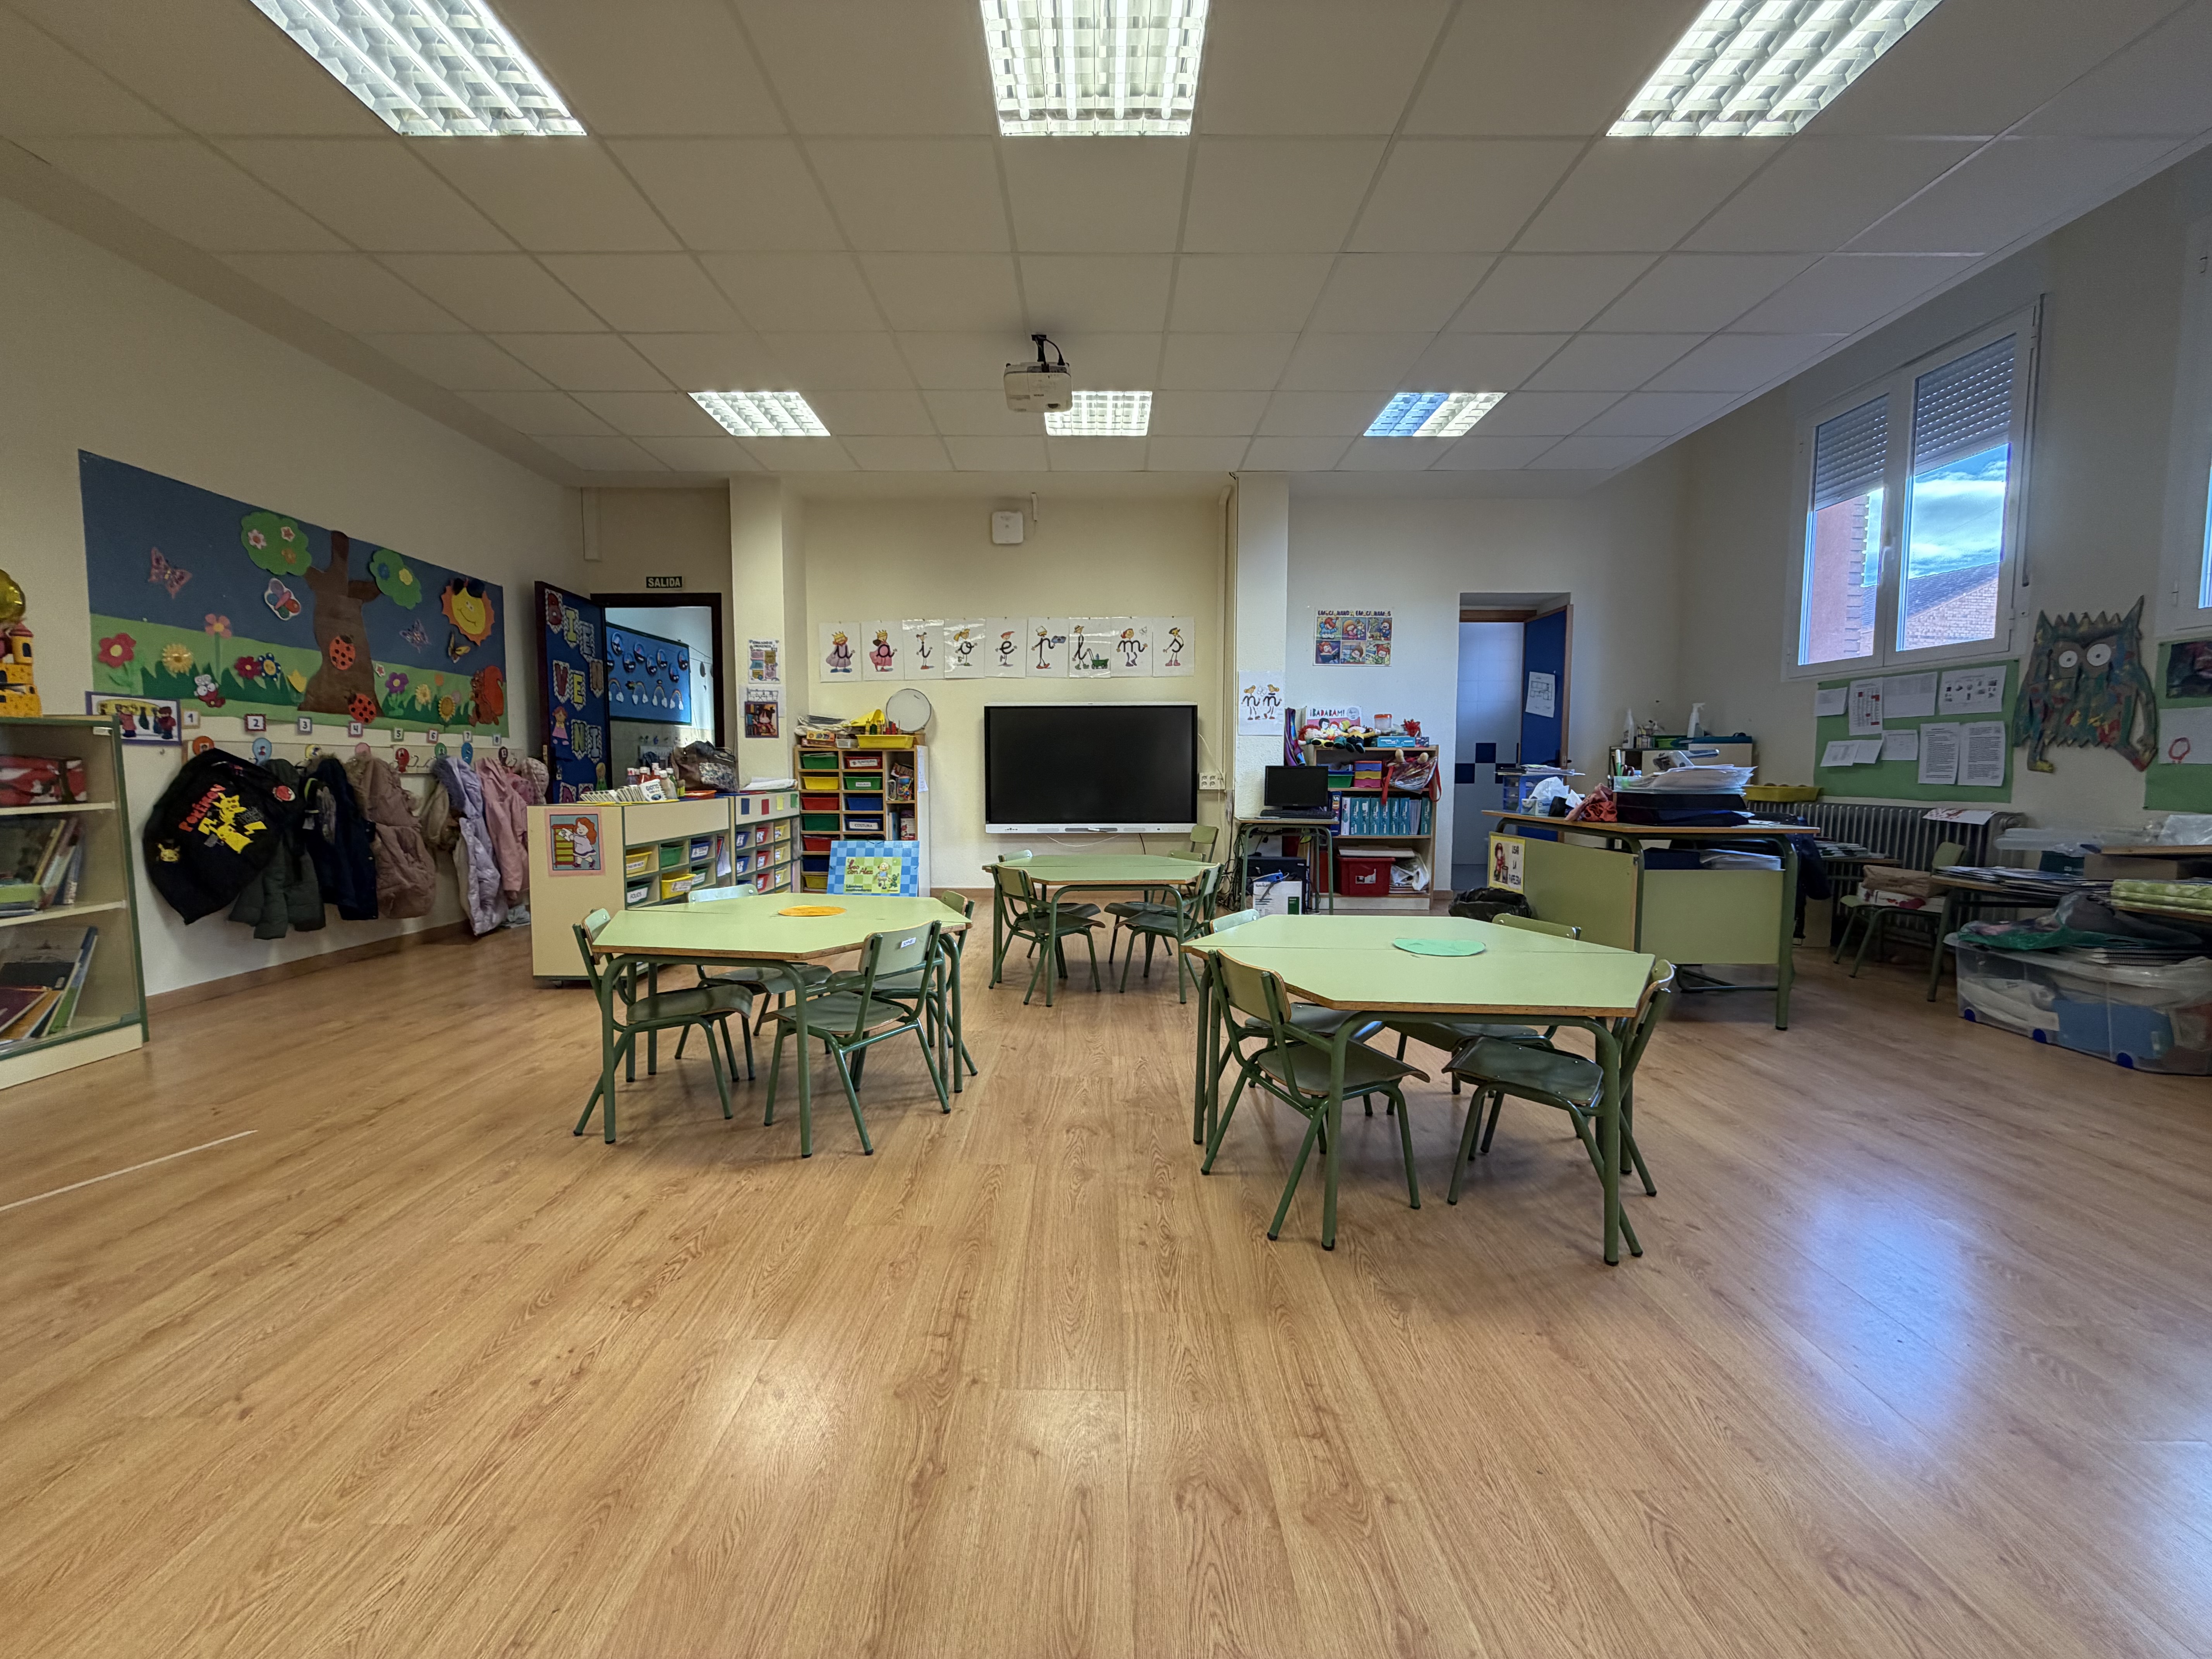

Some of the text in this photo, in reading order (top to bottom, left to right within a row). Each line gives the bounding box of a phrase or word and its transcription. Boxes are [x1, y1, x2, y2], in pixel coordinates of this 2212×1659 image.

[648, 577, 680, 587] SALIDA
[876, 644, 895, 658] a
[999, 641, 1015, 654] e
[1118, 640, 1146, 653] m
[1242, 693, 1280, 707] n ñ
[188, 713, 193, 722] 1
[1310, 708, 1345, 717] ¡BADABAM!
[253, 719, 259, 727] 2
